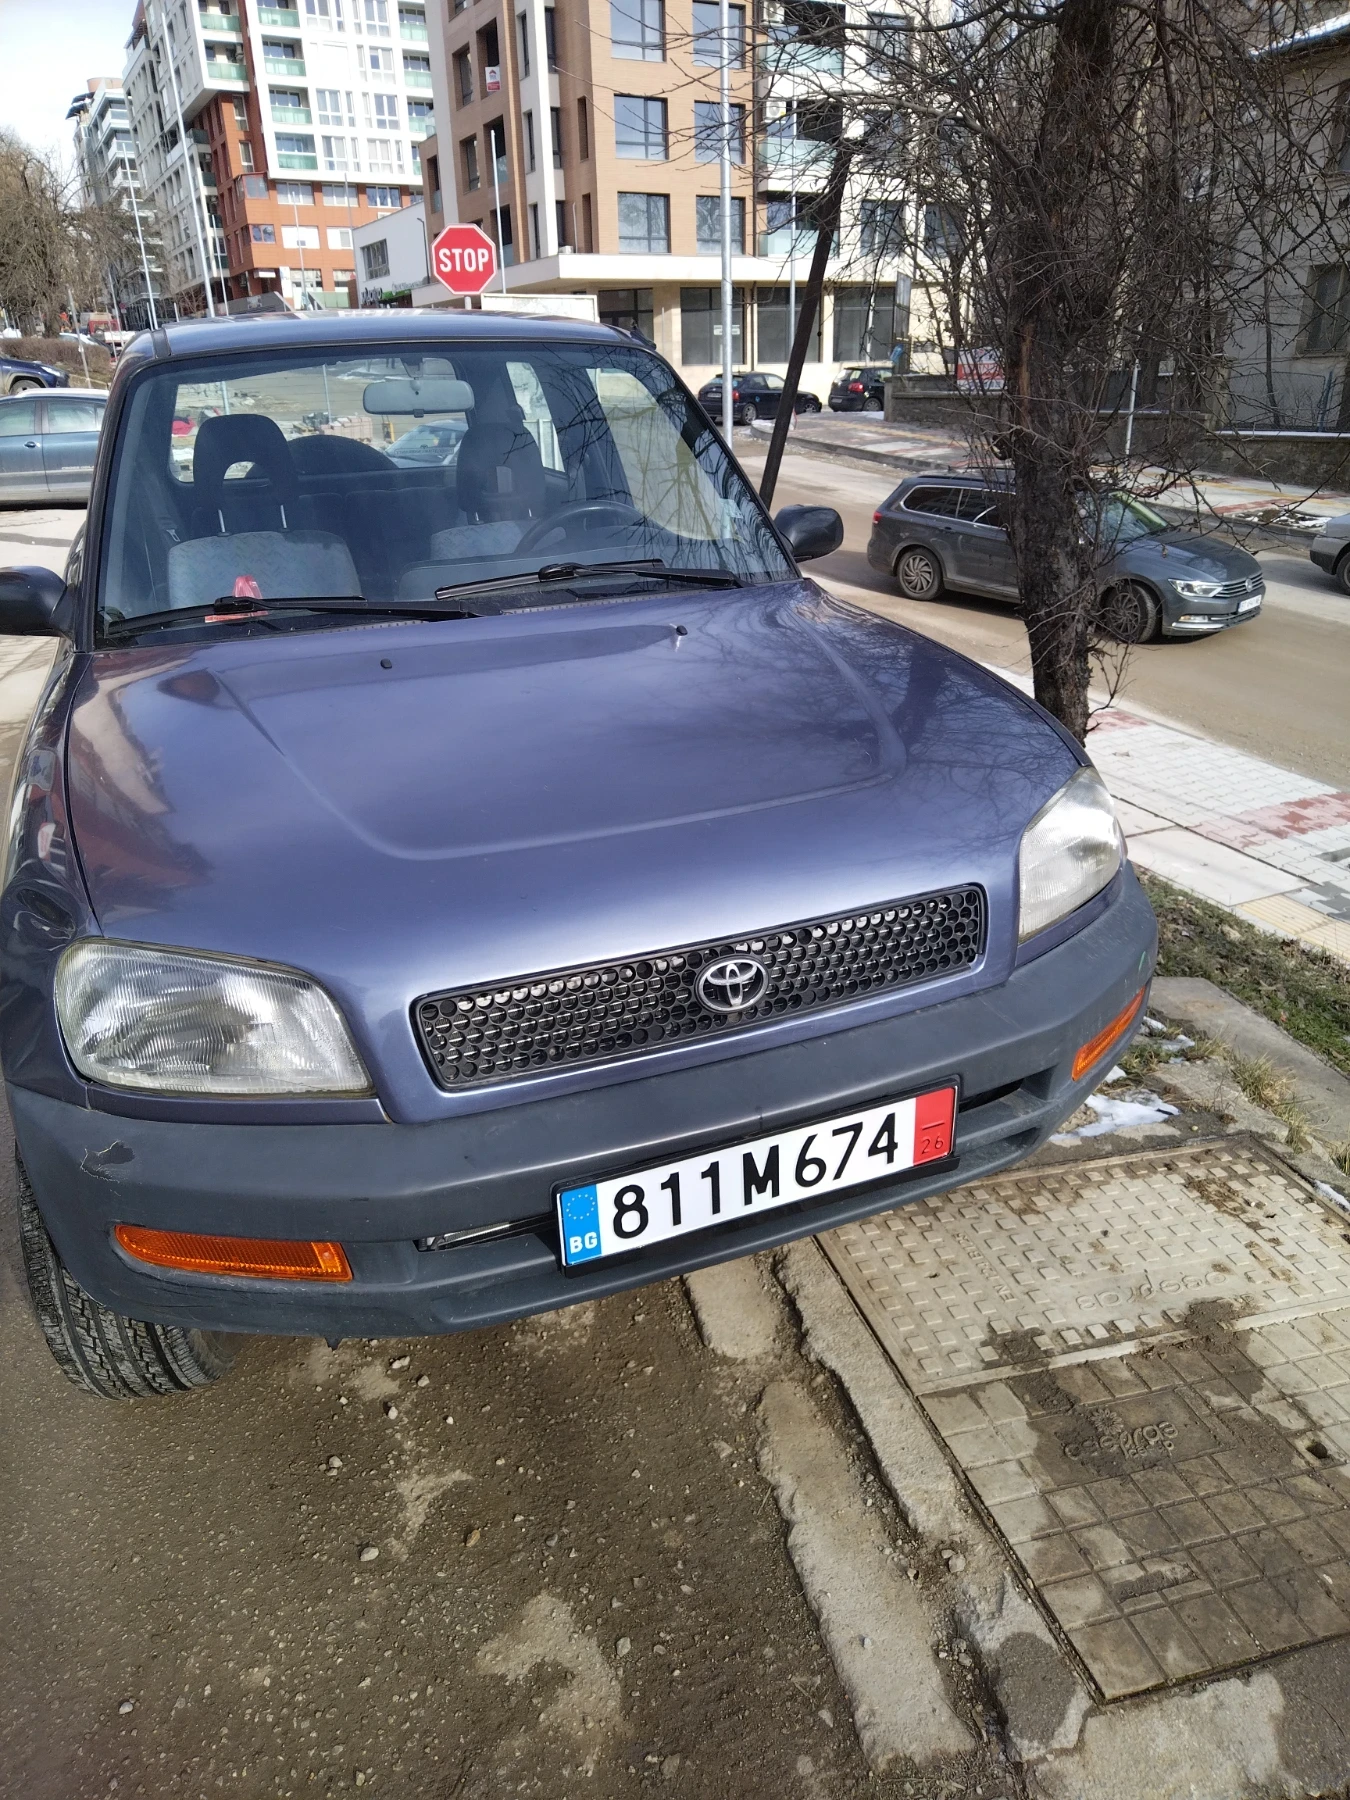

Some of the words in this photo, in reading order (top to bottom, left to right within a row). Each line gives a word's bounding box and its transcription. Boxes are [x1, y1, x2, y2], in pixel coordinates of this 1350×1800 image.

[438, 248, 489, 272] STOP
[921, 1132, 944, 1155] 26
[569, 1231, 598, 1255] BG
[993, 1284, 1017, 1303] EN
